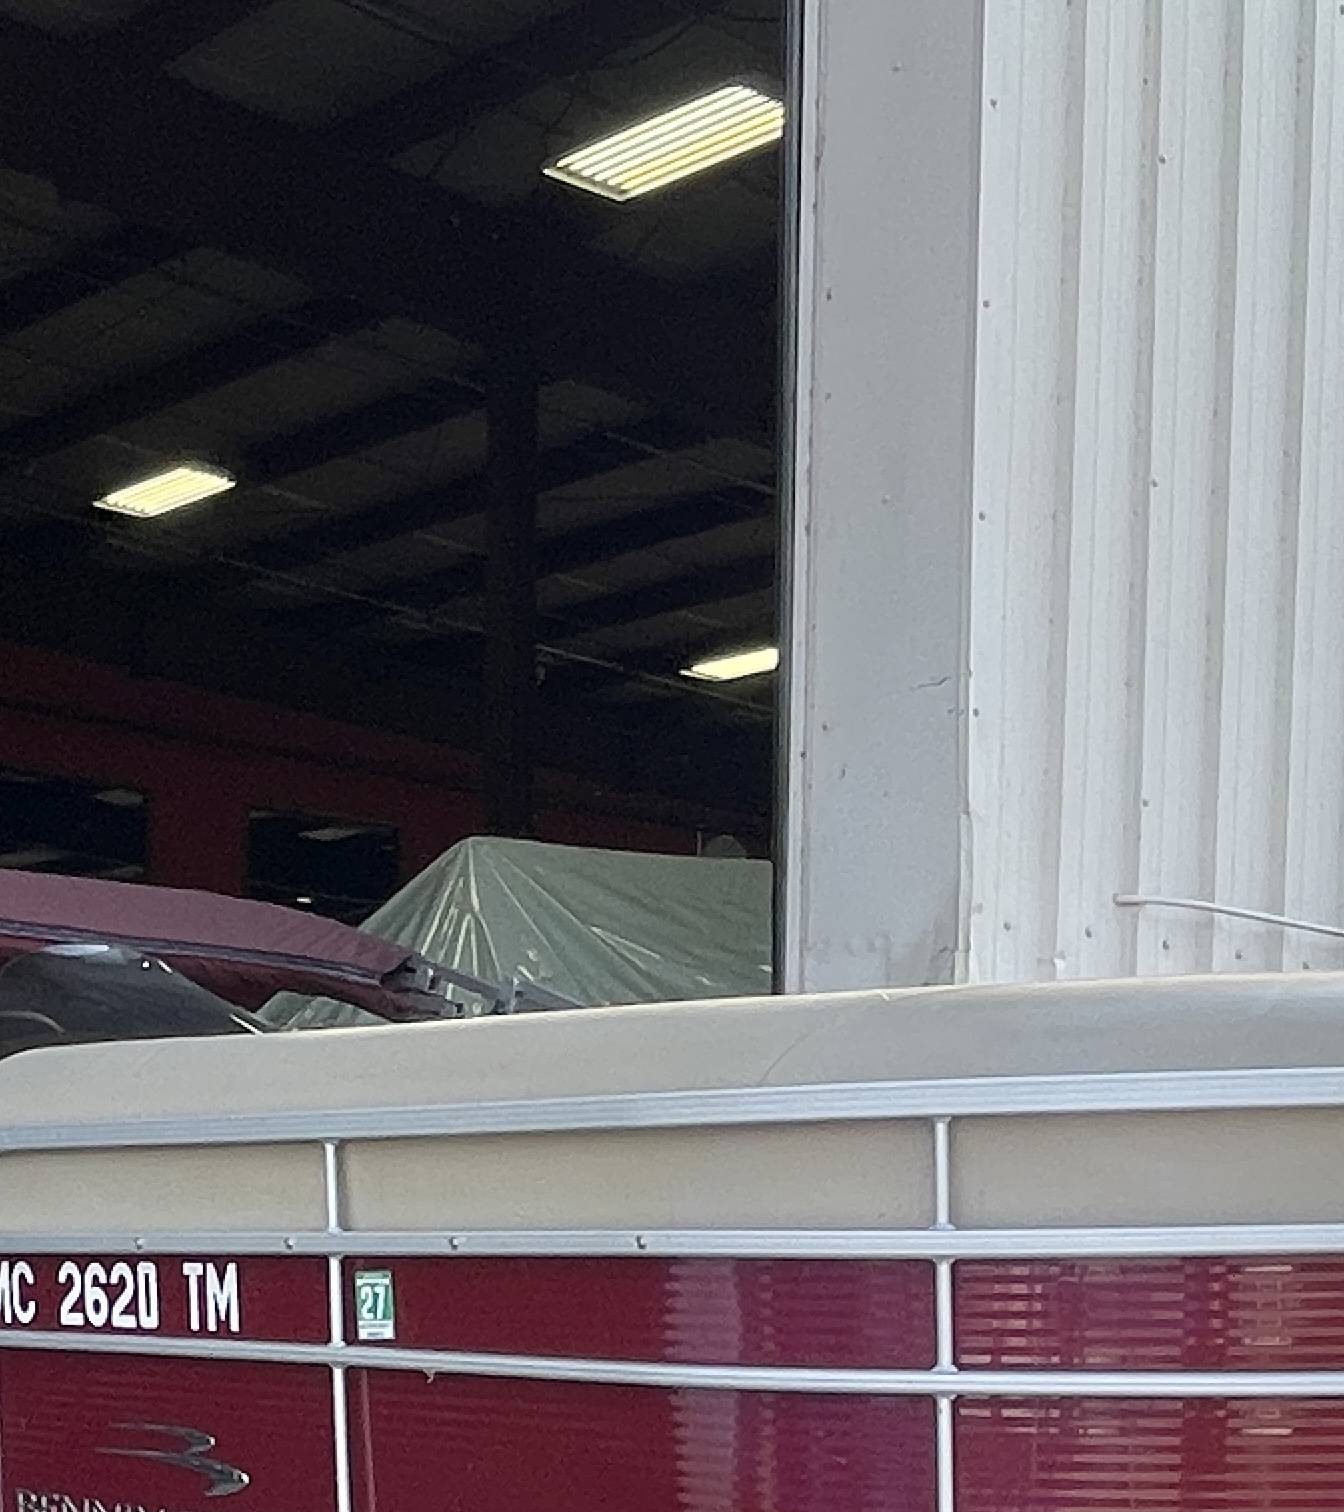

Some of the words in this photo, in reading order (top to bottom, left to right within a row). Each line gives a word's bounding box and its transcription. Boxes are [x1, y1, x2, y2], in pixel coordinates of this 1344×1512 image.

[58, 1260, 160, 1330] 2620
[182, 1261, 240, 1332] TM
[360, 1285, 386, 1320] 27
